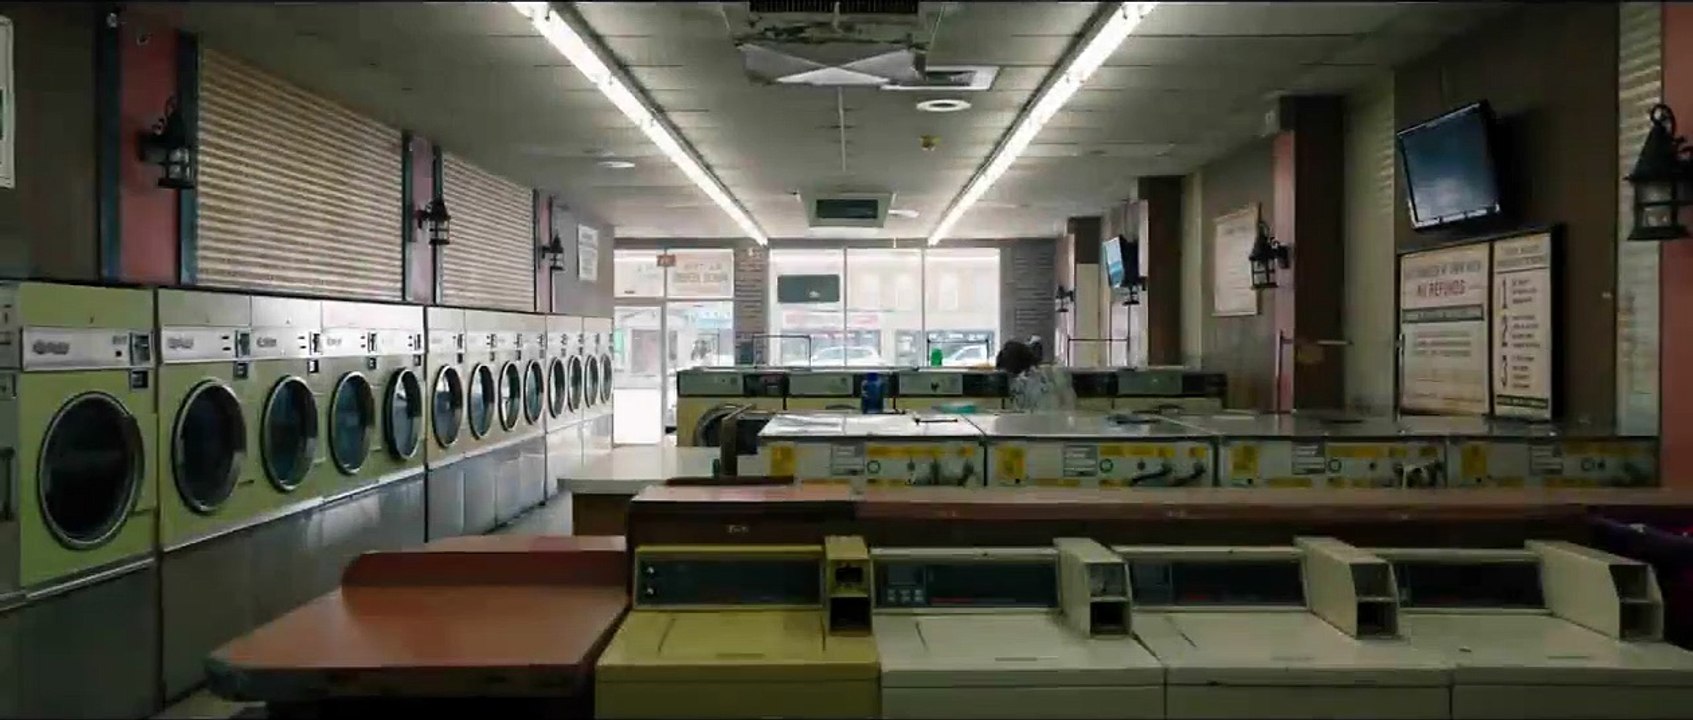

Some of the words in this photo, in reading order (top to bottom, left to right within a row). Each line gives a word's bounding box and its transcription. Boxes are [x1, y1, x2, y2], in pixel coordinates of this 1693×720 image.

[1428, 279, 1467, 297] REFUNDS
[1501, 277, 1508, 309] 1
[1501, 314, 1509, 348] 2
[1500, 354, 1509, 388] 3
